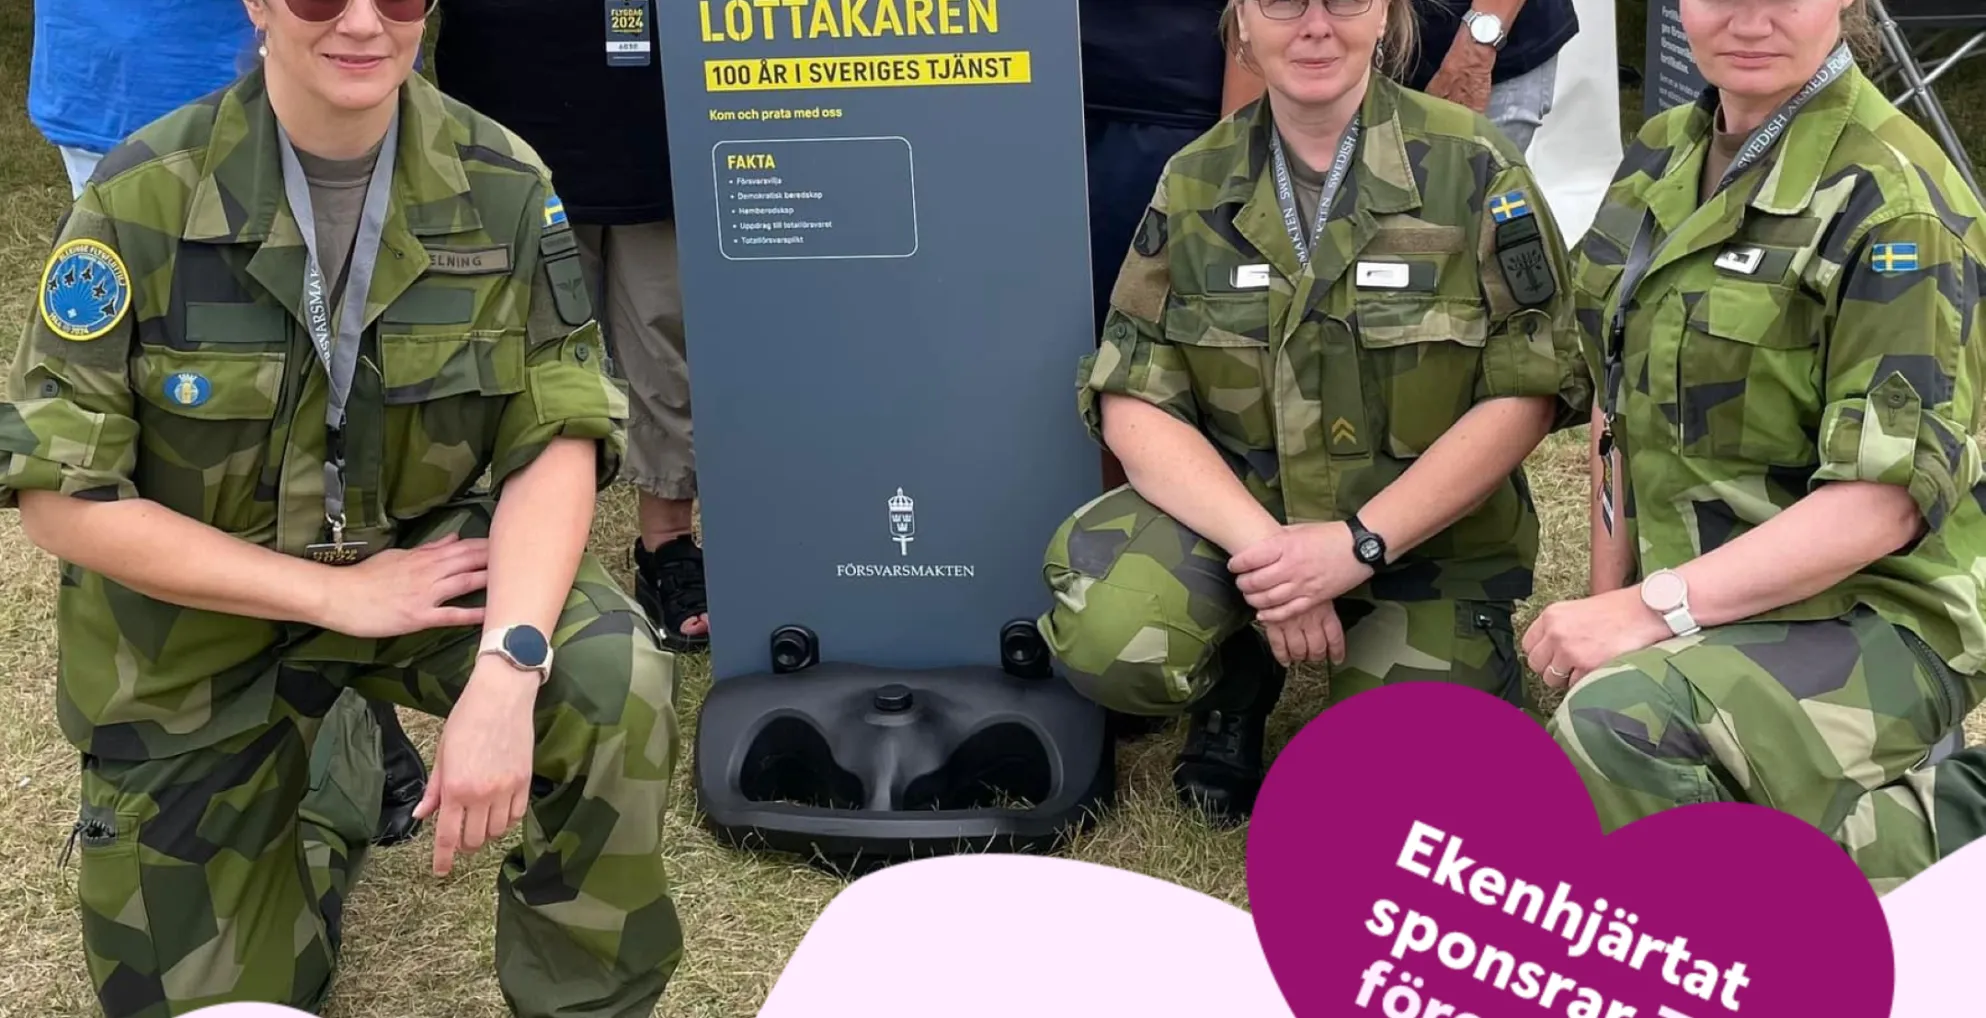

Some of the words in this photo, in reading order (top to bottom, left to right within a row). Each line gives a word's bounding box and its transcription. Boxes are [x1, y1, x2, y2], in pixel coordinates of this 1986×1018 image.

[611, 17, 644, 28] 2024
[712, 65, 751, 86] 100
[758, 58, 788, 85] ÅR
[796, 63, 801, 83] I
[809, 60, 921, 83] SVERIGES
[926, 54, 1013, 79] TJÄNST
[709, 109, 736, 121] Kom
[737, 108, 760, 120] och
[761, 107, 792, 122] prata
[793, 106, 820, 119] med
[821, 107, 843, 119] oss
[1737, 113, 1788, 170] SWEDISH
[727, 154, 776, 170] FAKTA
[1327, 134, 1357, 190] SWEDISH
[736, 176, 783, 186] Försvarsvilja
[737, 192, 783, 200] Demokratisk
[784, 190, 823, 200] beredskap
[740, 222, 772, 231] Uppdrag
[430, 254, 483, 268] ELNING
[836, 563, 975, 577] FÖRSVARSMAKTEN
